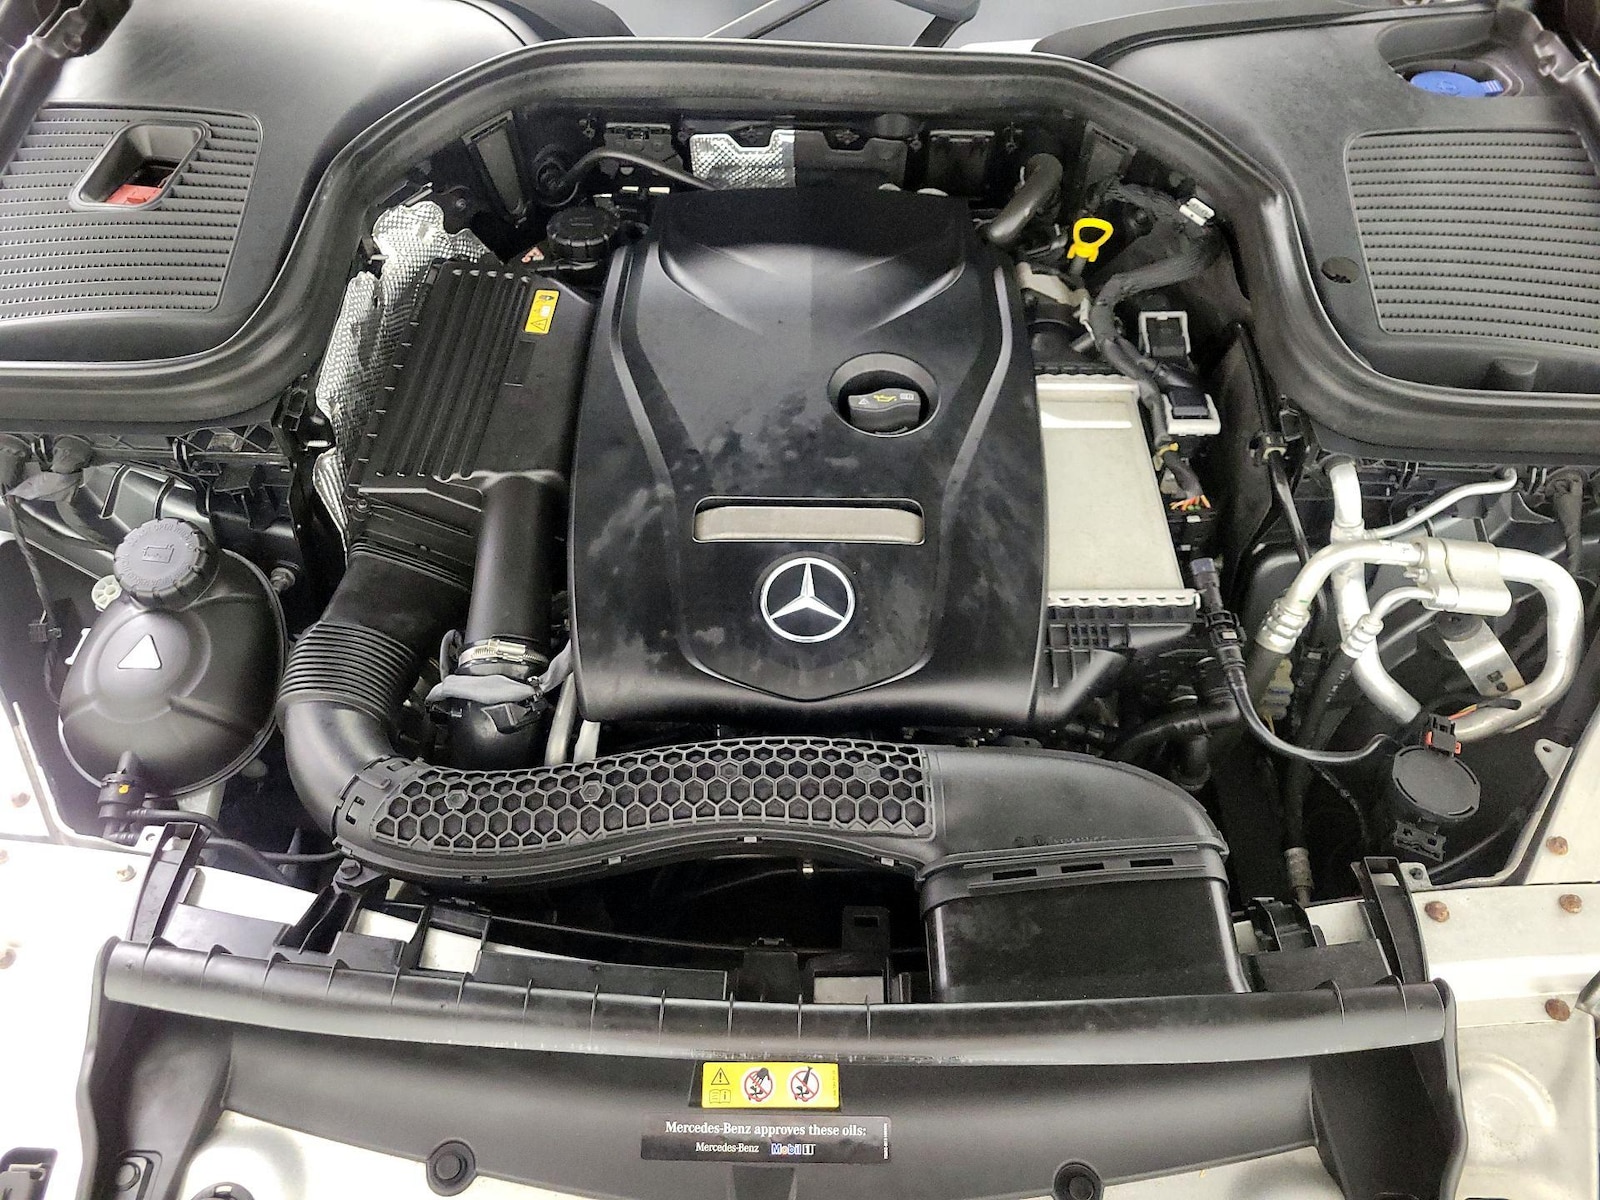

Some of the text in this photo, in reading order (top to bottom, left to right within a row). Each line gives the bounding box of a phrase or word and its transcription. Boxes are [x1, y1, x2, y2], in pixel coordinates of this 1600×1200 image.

[665, 1121, 867, 1137] Mercedes-Benz approves these oils:
[695, 1142, 759, 1153] Mercedes-Benz
[771, 1143, 801, 1155] Mobil
